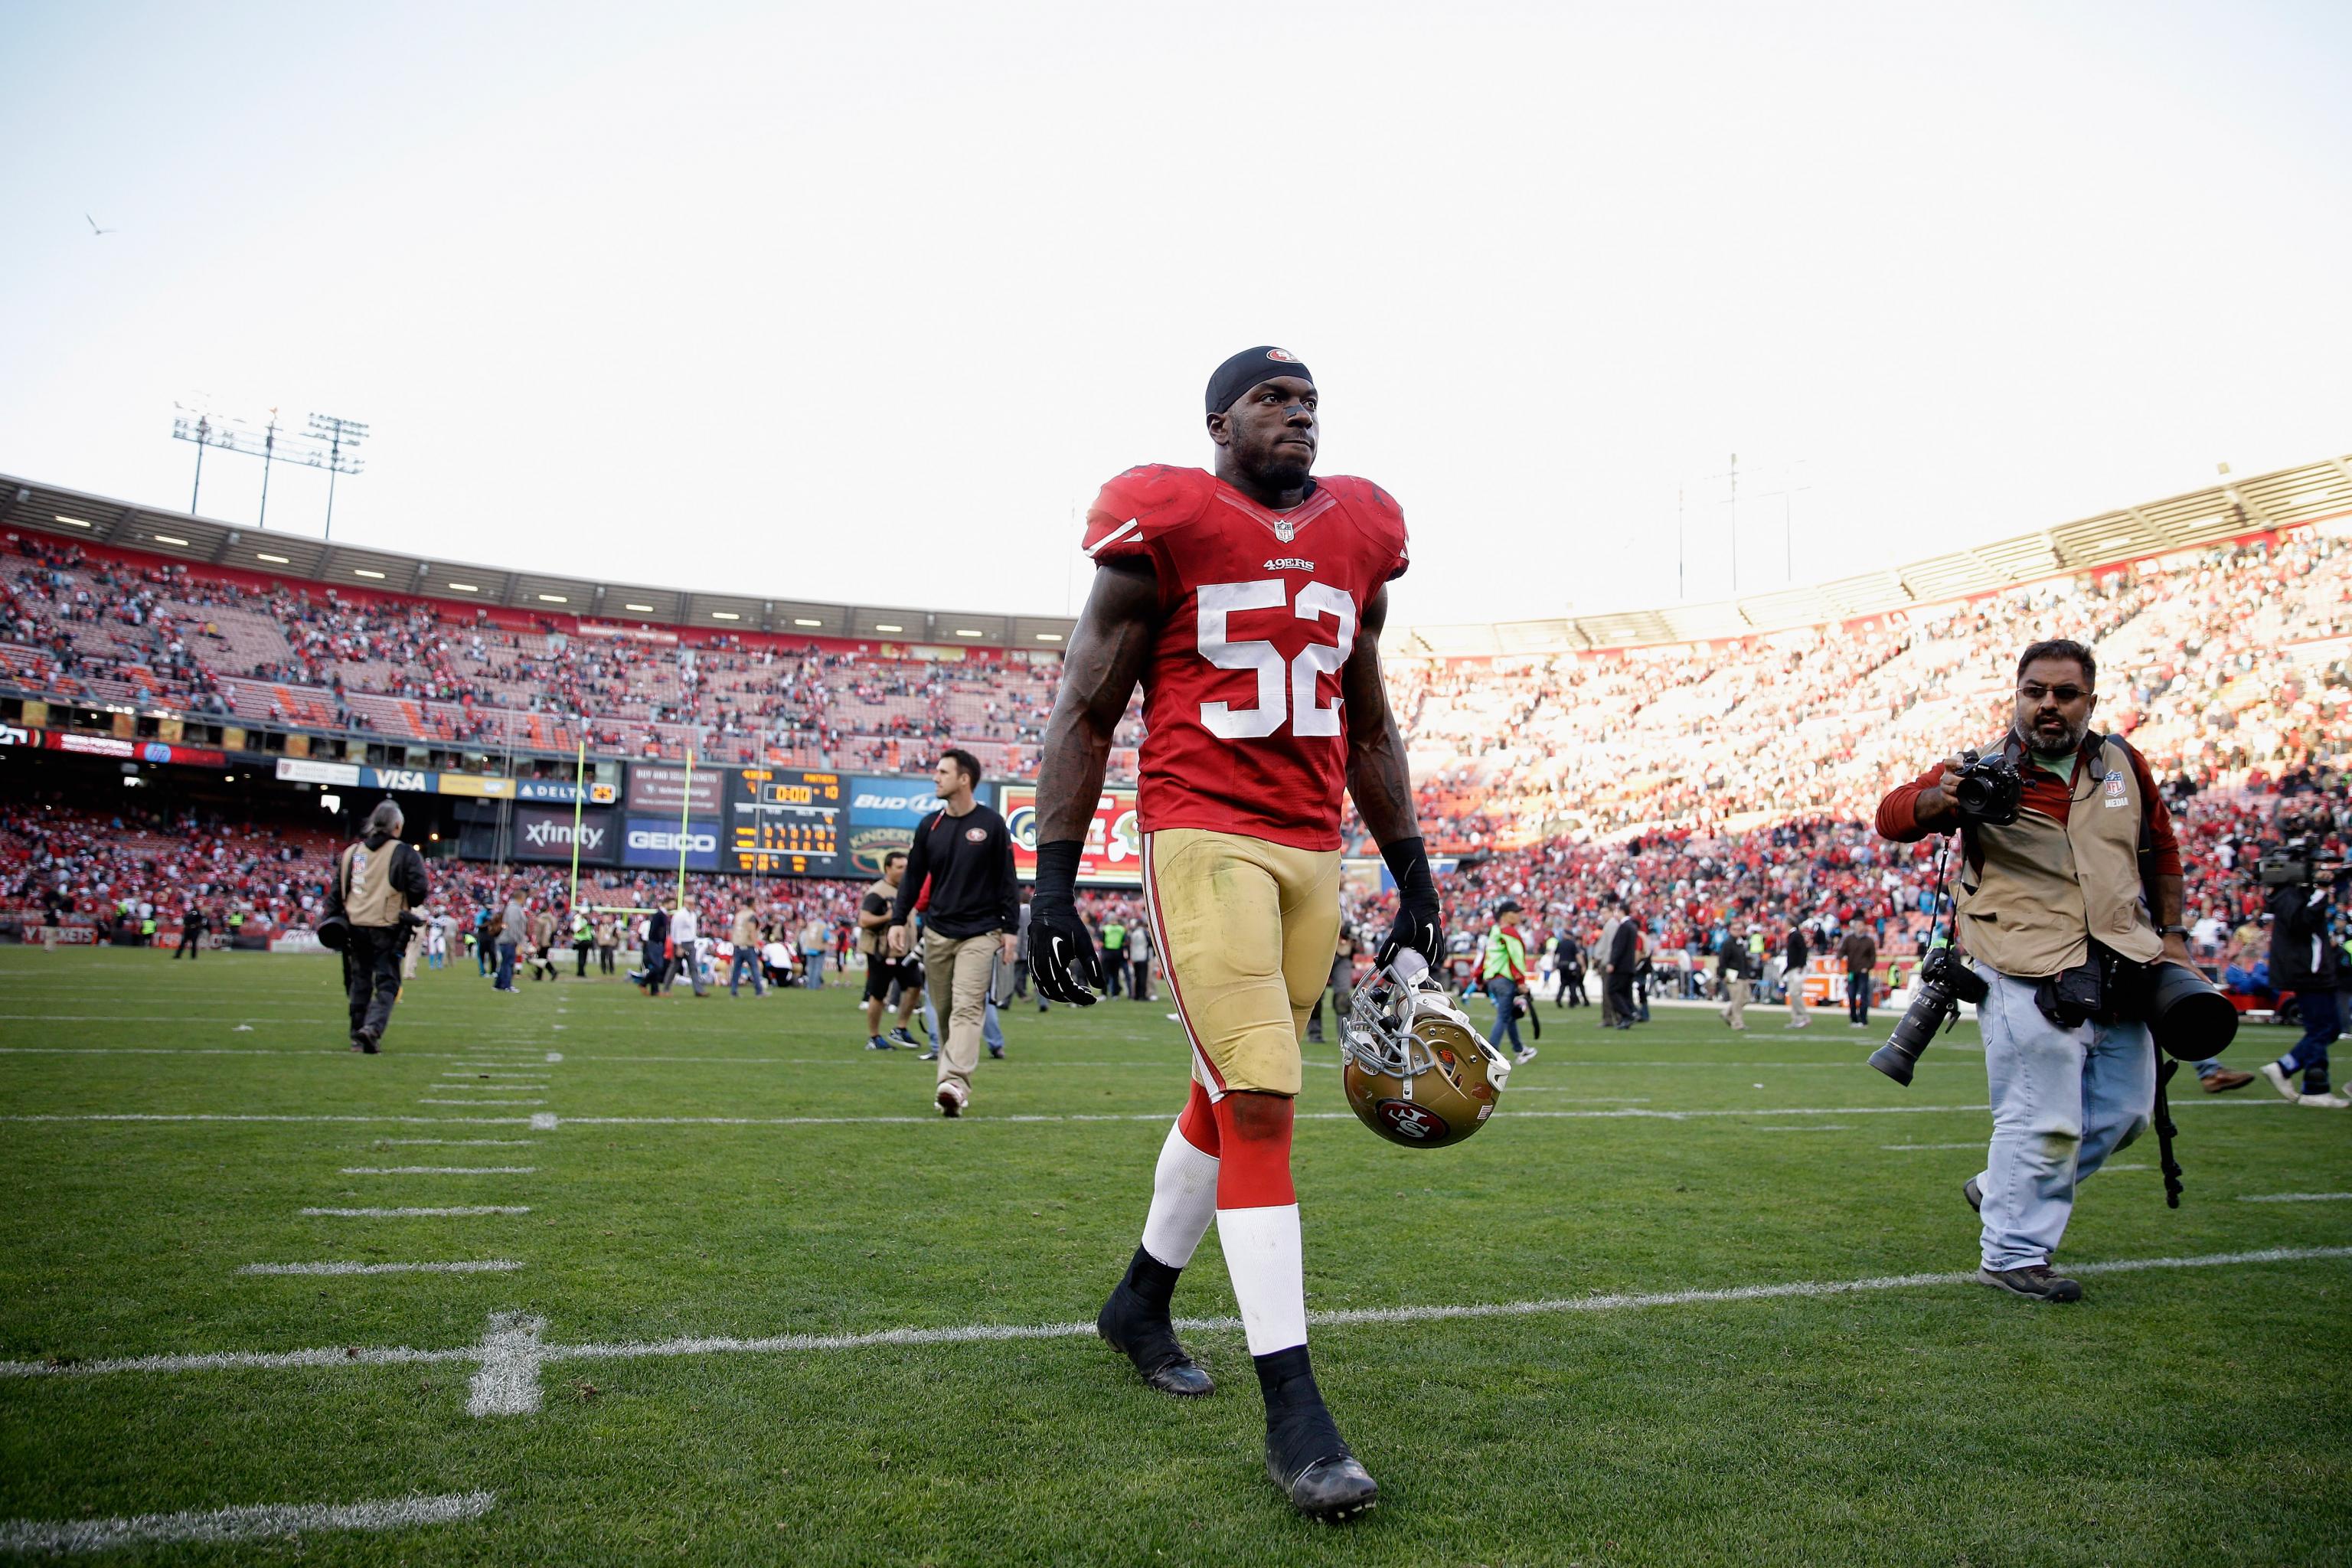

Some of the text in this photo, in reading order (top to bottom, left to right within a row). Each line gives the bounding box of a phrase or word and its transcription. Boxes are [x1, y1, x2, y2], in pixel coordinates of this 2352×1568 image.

[1279, 530, 1293, 540] NFL
[1263, 557, 1315, 573] 49ERS
[1196, 578, 1357, 740] 52
[374, 769, 426, 792] VISA
[2107, 781, 2122, 792] NFL
[537, 785, 587, 799] DELTA
[776, 786, 811, 802] 0:00
[854, 793, 909, 811] BUD
[2105, 797, 2129, 808] MEDIA
[526, 819, 604, 851] xfinity
[628, 830, 716, 853] GEICO
